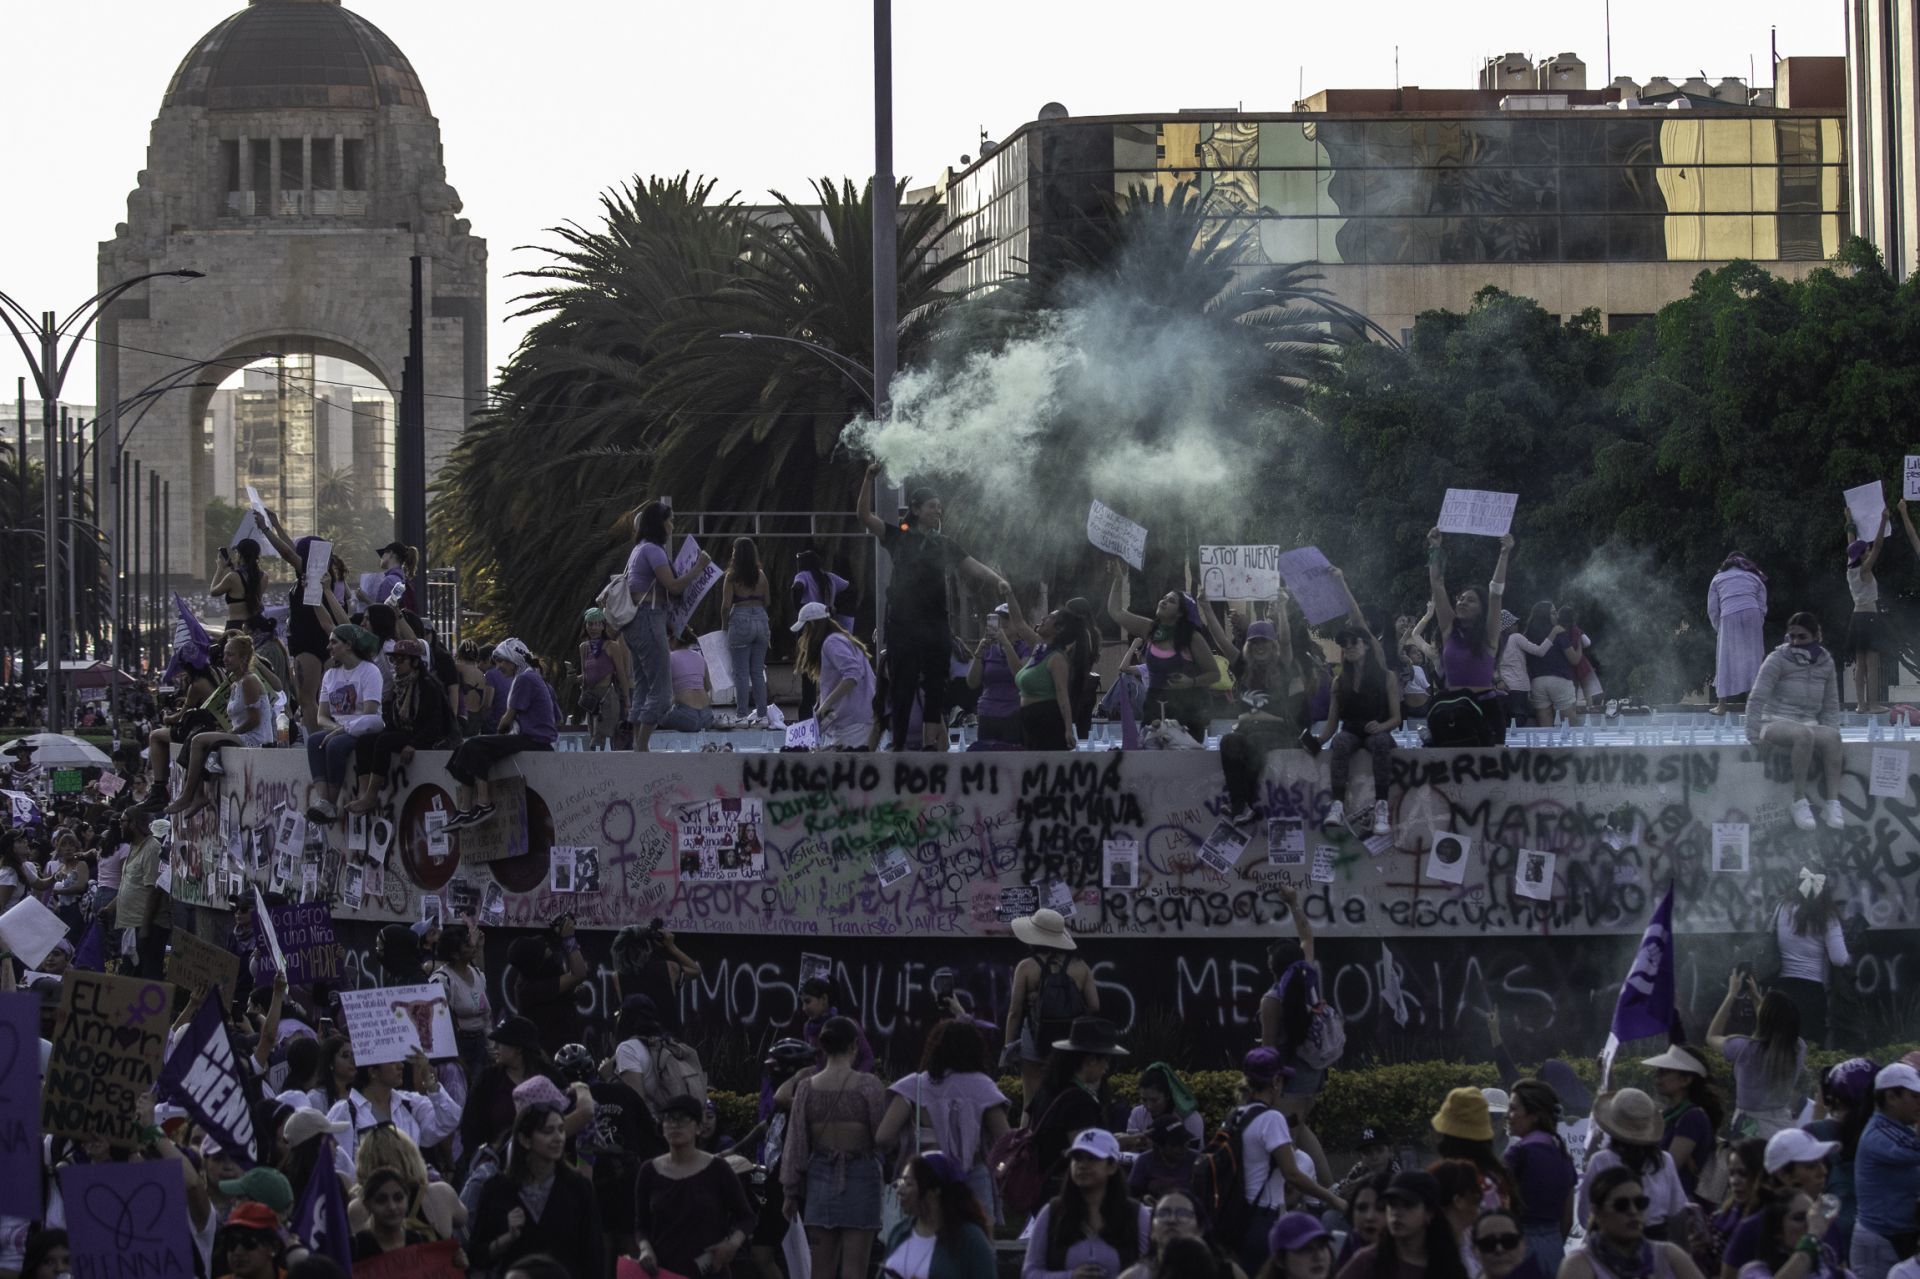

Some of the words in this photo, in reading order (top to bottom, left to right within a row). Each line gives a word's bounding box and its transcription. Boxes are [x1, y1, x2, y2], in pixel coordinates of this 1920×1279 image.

[743, 758, 880, 794] MARCHO
[894, 761, 950, 794] POR
[961, 762, 999, 794] MI
[1656, 751, 1721, 789] SIN
[282, 908, 323, 926] quiero
[1303, 884, 1367, 924] de
[300, 944, 340, 980] MADRE
[71, 980, 109, 1020] EL
